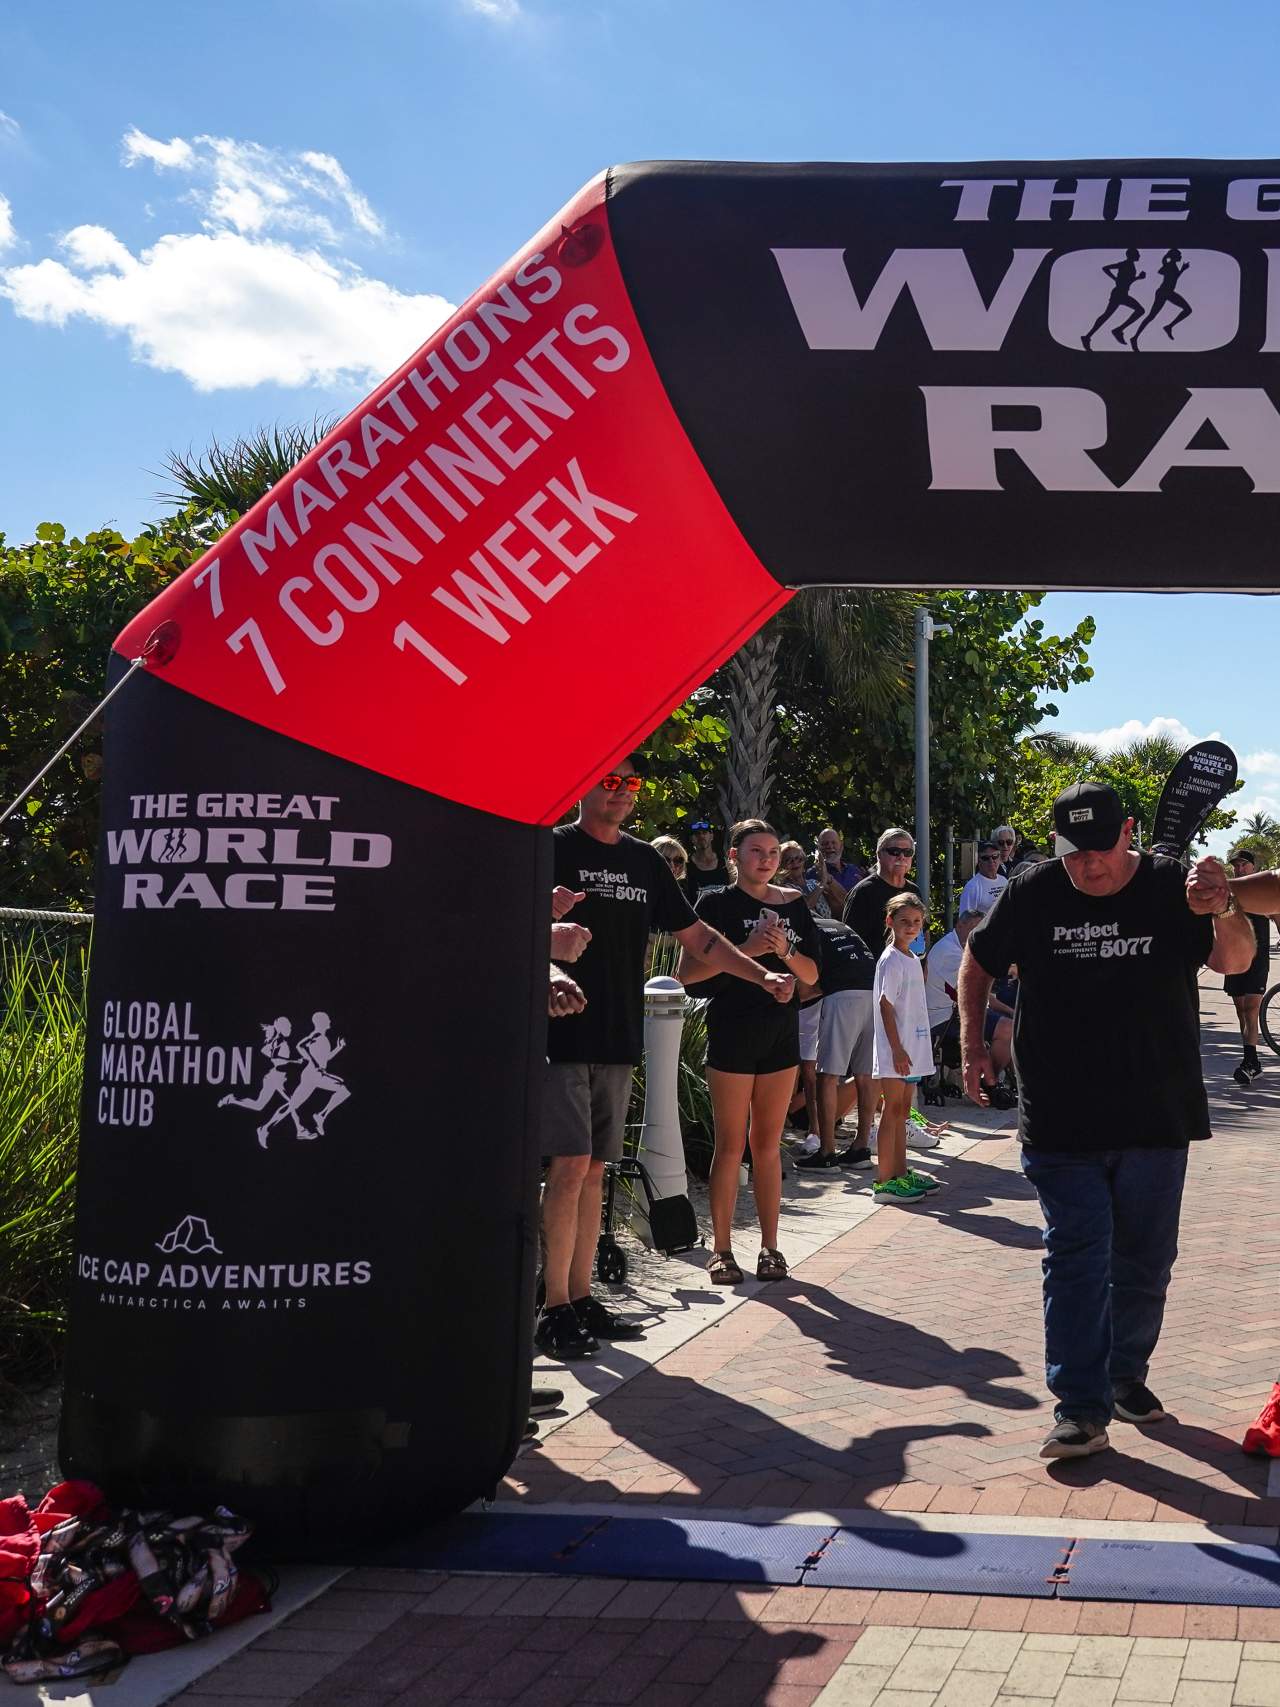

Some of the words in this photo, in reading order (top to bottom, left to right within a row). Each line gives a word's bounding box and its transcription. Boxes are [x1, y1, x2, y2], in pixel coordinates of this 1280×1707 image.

[941, 179, 1190, 221] THE
[194, 558, 224, 618] 7
[239, 253, 562, 576] MARATHONS
[226, 618, 286, 695] 7
[278, 304, 630, 646] CONTINENTS
[393, 621, 467, 686] 1
[432, 457, 638, 645] WEEK
[1188, 755, 1233, 771] WORLD
[1193, 763, 1225, 776] RACE
[1208, 753, 1228, 762] GREAT
[130, 794, 187, 819] THE
[197, 794, 340, 821] GREAT
[107, 828, 392, 868] WORLD
[123, 873, 336, 911] RACE
[578, 869, 629, 884] Project
[616, 885, 647, 903] 5077
[1053, 922, 1120, 941] Project
[1100, 936, 1153, 959] 5077
[104, 1000, 199, 1040] GLOBAL
[101, 1043, 253, 1085] MARATHON
[98, 1086, 154, 1127] CLUB
[78, 1254, 100, 1280] ICE
[104, 1260, 150, 1286] CAP
[158, 1261, 372, 1289] ADVENTURES
[100, 1293, 206, 1310] ANTARCTICA
[222, 1298, 306, 1310] AWAITS
